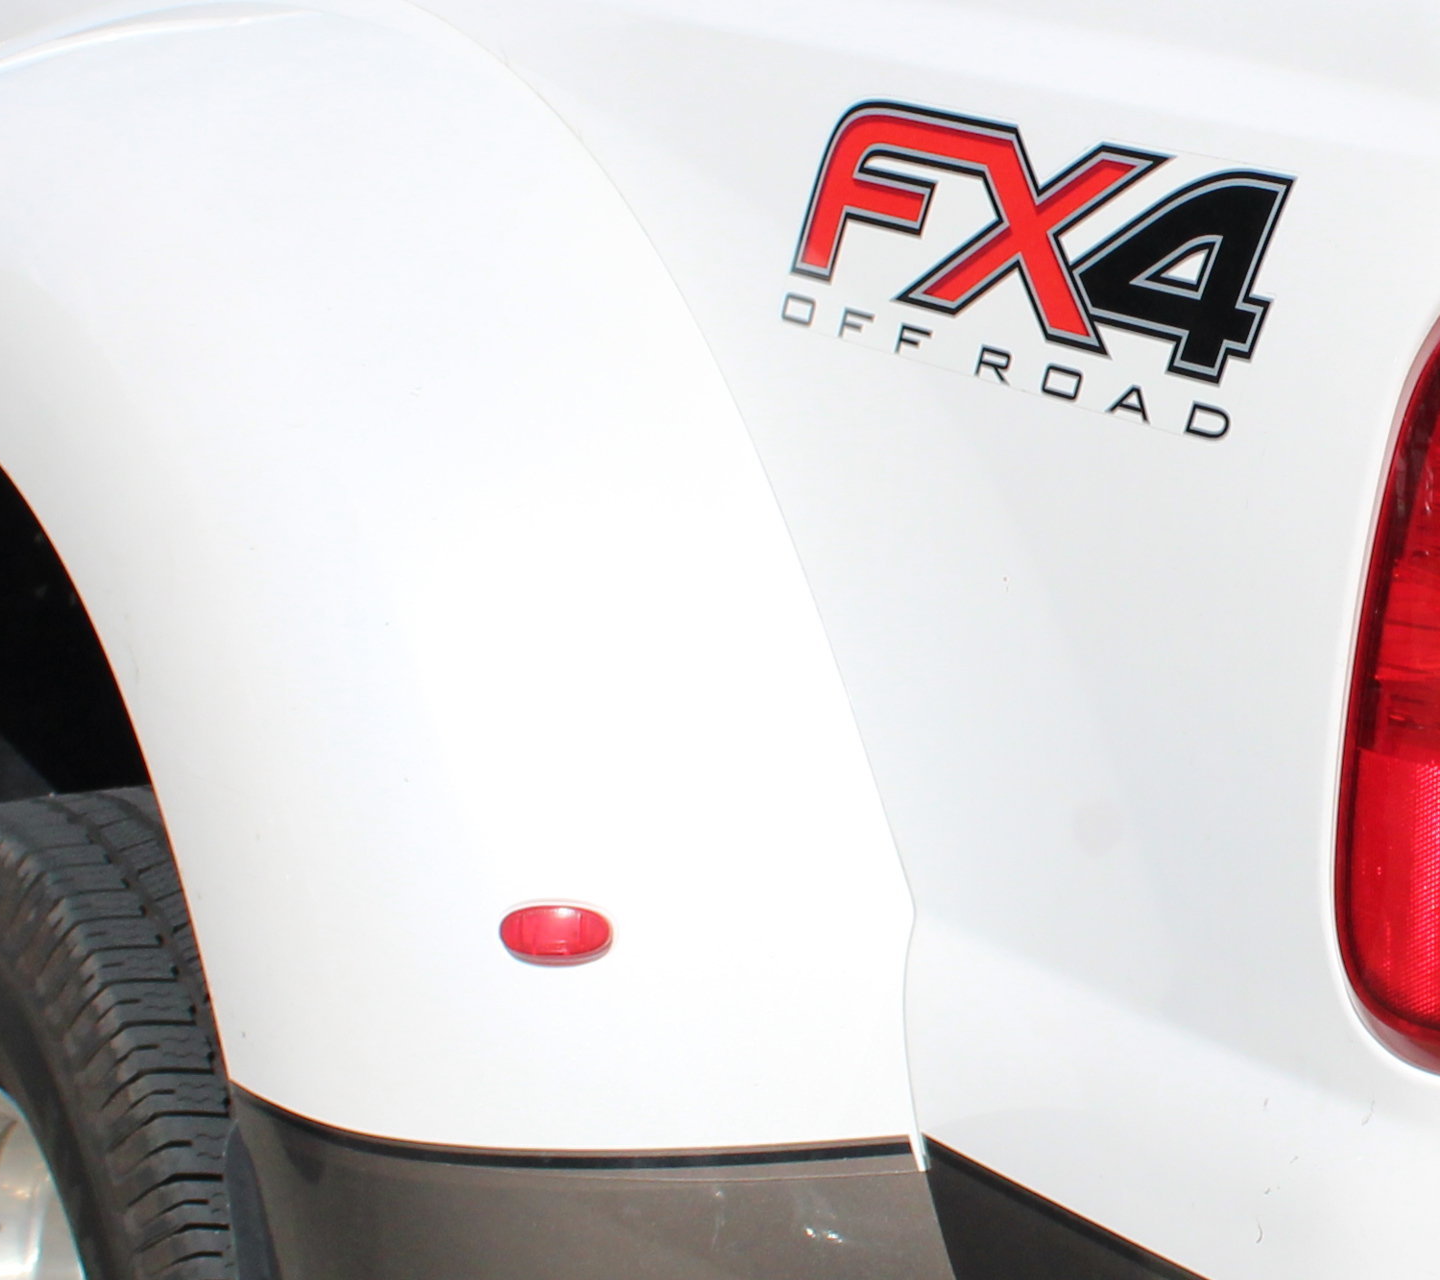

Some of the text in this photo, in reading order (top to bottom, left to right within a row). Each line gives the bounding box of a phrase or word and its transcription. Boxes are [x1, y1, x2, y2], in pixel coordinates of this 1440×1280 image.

[790, 101, 1299, 384] FX4
[780, 290, 1231, 441] OFF ROAD
